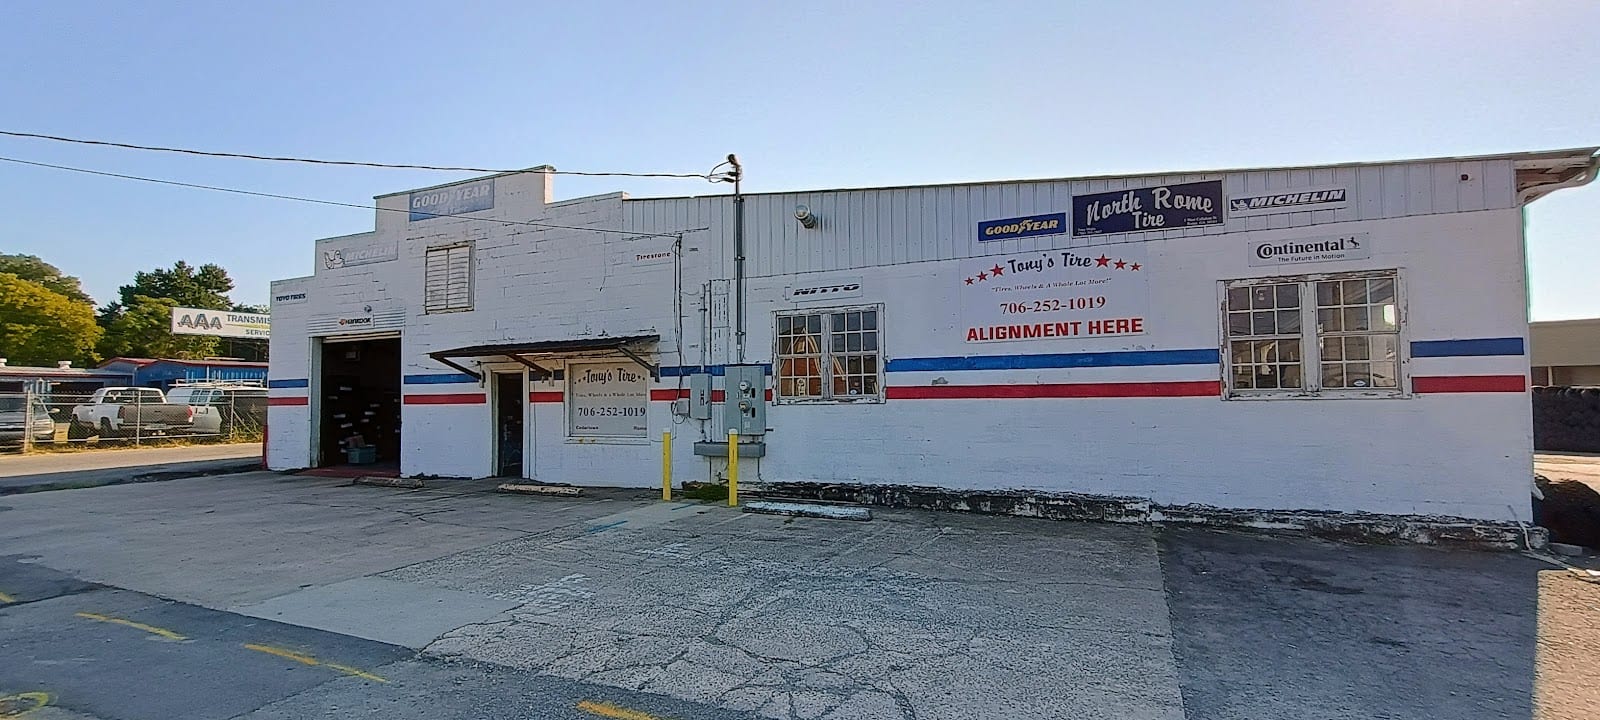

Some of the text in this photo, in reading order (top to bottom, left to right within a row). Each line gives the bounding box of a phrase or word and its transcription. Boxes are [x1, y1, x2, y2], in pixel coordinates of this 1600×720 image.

[1086, 187, 1213, 226] North Rome
[1249, 190, 1343, 208] MICHELIN
[985, 218, 1059, 236] GOODYEAR
[1131, 211, 1165, 229] Tire
[345, 246, 397, 262] MICHELIN
[636, 252, 671, 261] Firestone
[1256, 238, 1344, 260] Continental
[1321, 253, 1344, 261] Motion
[1007, 252, 1092, 274] Tony's Tire
[290, 293, 306, 301] TIRES
[793, 283, 860, 296] NITTO
[1000, 296, 1106, 314] 706-252-1019
[177, 313, 223, 330] AAA
[967, 318, 1143, 341] ALIGNMENT HERE
[585, 368, 637, 385] Tony's Tire
[578, 407, 646, 417] 706-252-1019
